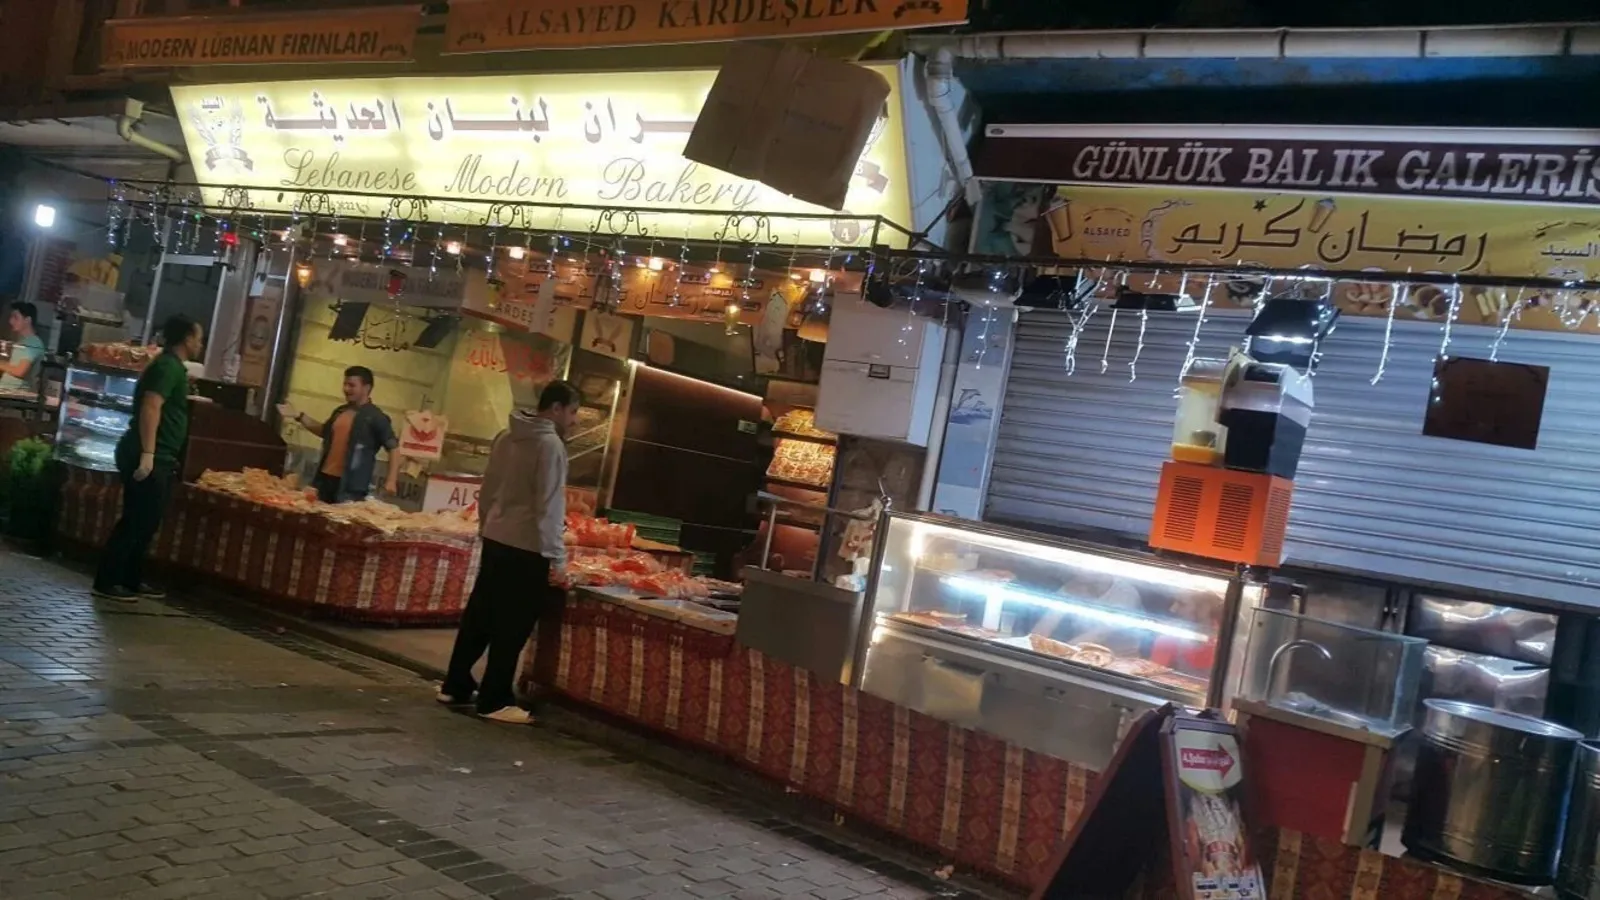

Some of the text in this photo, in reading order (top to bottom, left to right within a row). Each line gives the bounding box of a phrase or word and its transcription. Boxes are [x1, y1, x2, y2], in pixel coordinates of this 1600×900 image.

[498, 4, 636, 36] ALSAYED
[126, 37, 197, 60] MODERN
[281, 31, 378, 55] FIRINLARI
[257, 90, 402, 142] الحديثة
[427, 96, 550, 143] لبنان
[281, 147, 760, 210] Lebanese Modern Bakery
[1072, 141, 1232, 184] GÜNLÜK
[1242, 148, 1384, 187] BALIK
[840, 227, 853, 241] 4
[1083, 226, 1130, 238] ALSAYED
[1167, 198, 1488, 271] رمضان كريم
